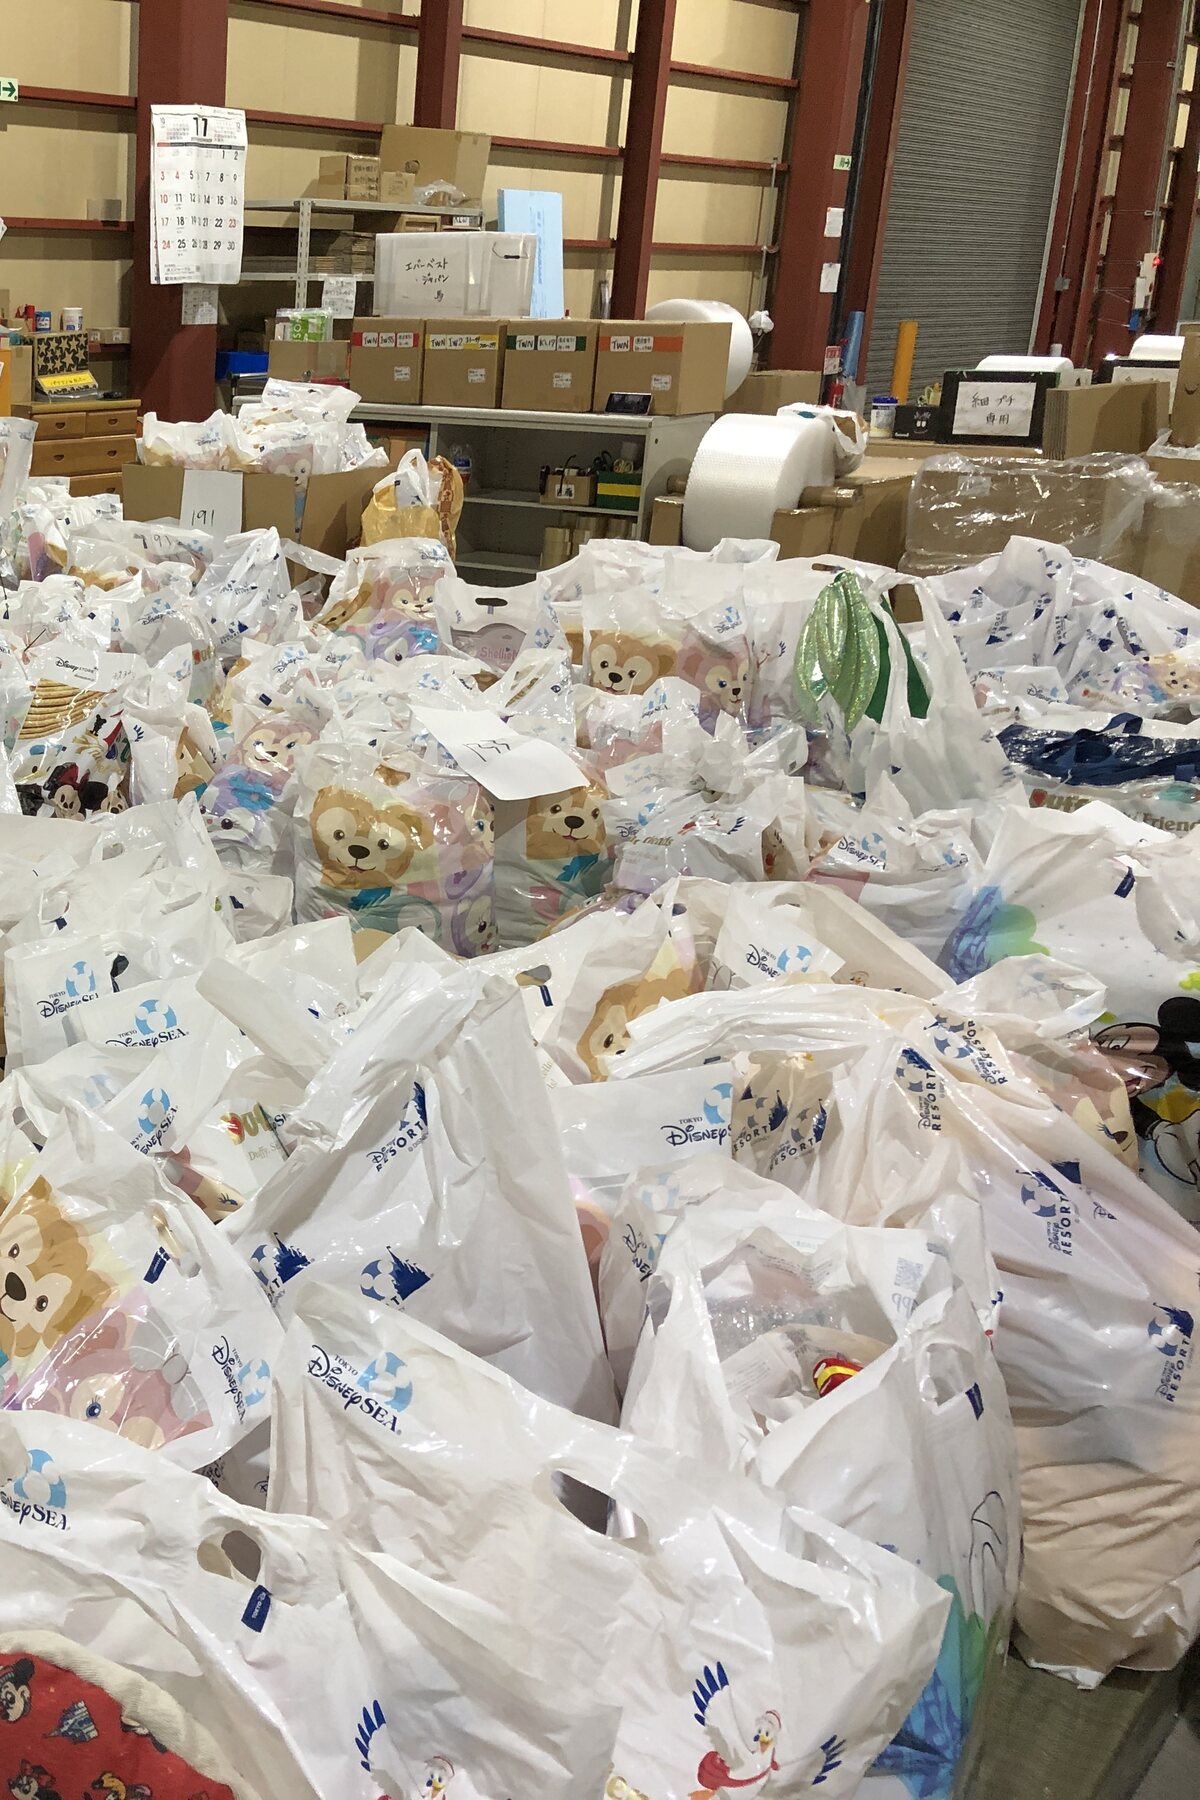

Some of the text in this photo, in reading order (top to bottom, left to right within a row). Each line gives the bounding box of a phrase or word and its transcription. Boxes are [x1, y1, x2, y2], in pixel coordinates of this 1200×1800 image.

[234, 151, 239, 160] 2
[161, 170, 238, 183] 3 4 5 7 8 9
[160, 194, 169, 204] 10
[175, 193, 183, 203] 11
[204, 194, 211, 205] 14
[217, 195, 225, 206] 15
[230, 196, 238, 206] 16
[161, 217, 169, 227] 17
[177, 216, 185, 226] 18
[215, 218, 223, 228] 22
[228, 218, 237, 228] 23
[162, 240, 170, 250] 24
[177, 239, 186, 249] 25
[213, 240, 221, 251] 29
[227, 241, 235, 251] 30
[432, 339, 445, 348] TWN
[518, 340, 533, 349] TWN
[612, 340, 629, 350] TWN
[191, 509, 214, 527] 191
[925, 1072, 942, 1131] RESORT
[679, 1116, 703, 1125] TOKYO
[733, 1126, 768, 1152] ESORT
[1060, 1196, 1072, 1256] RESORT
[334, 1354, 359, 1376] TOKYO
[1166, 1339, 1190, 1402] RESORT
[307, 1344, 399, 1433] DisneySEA
